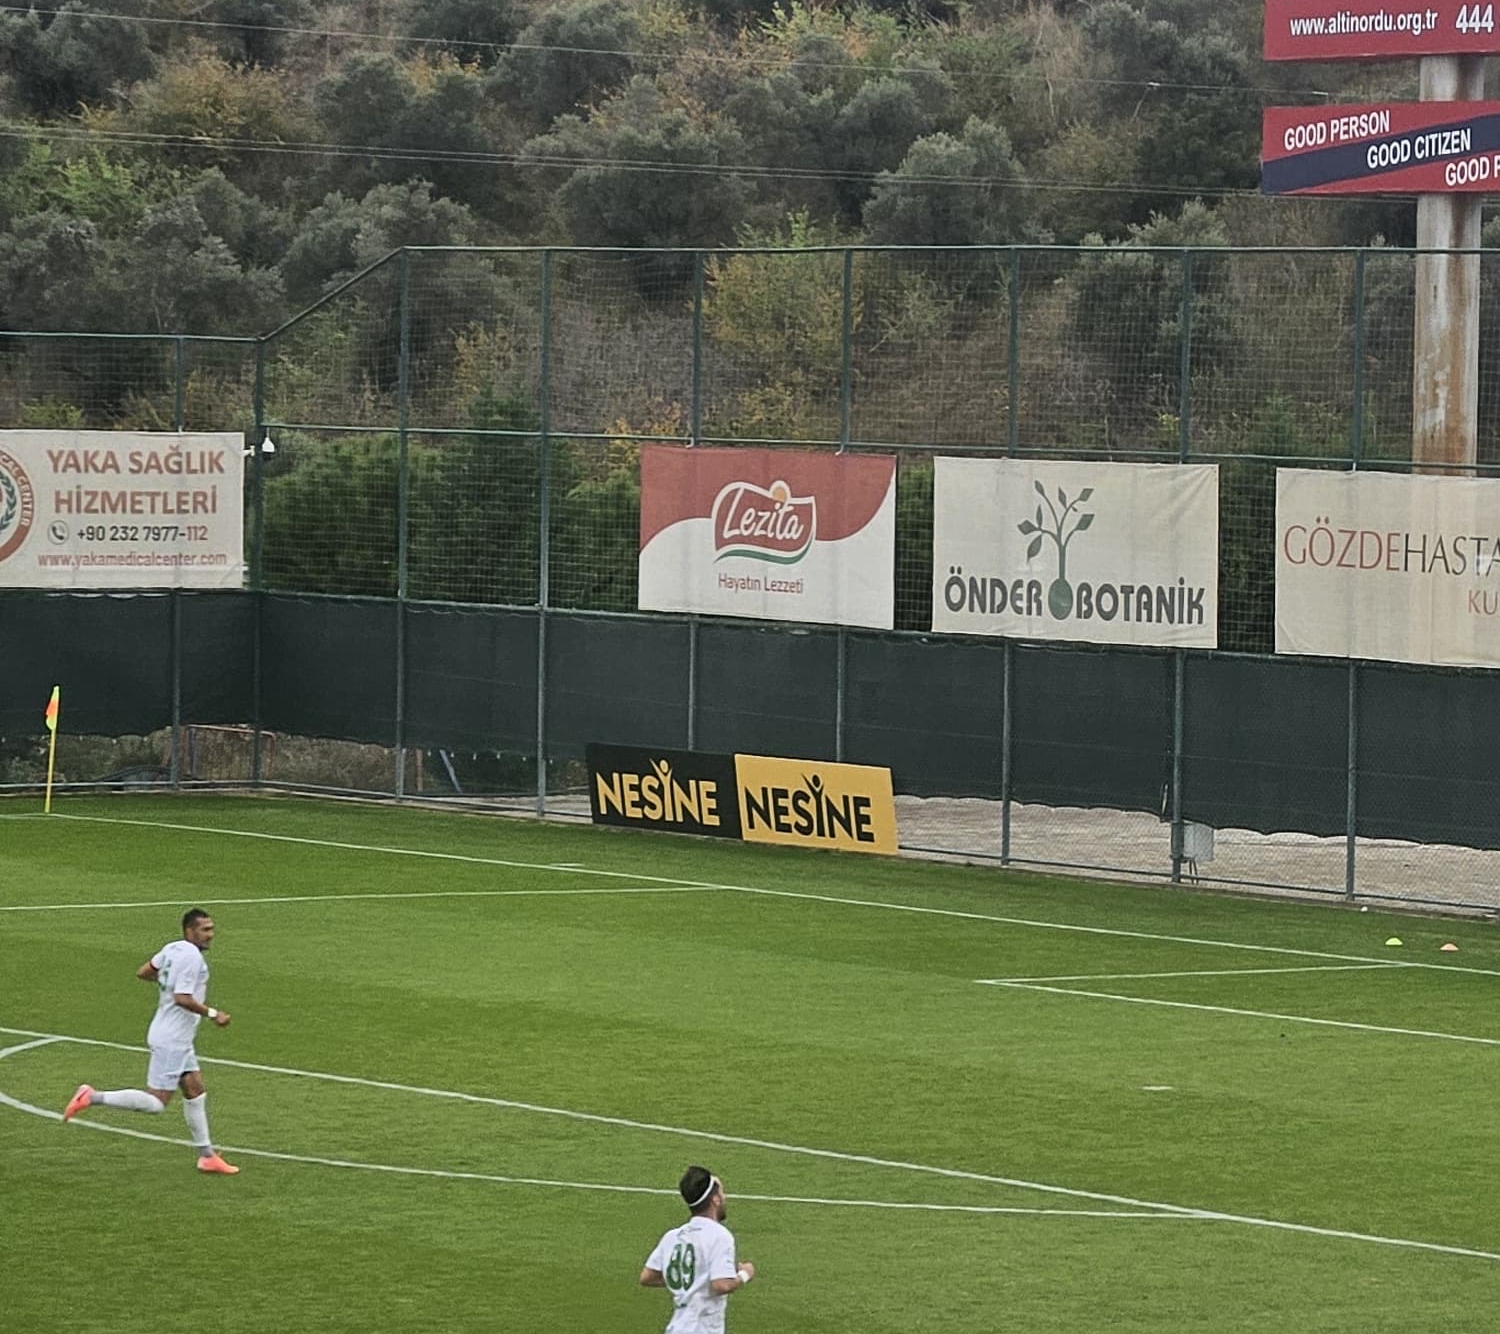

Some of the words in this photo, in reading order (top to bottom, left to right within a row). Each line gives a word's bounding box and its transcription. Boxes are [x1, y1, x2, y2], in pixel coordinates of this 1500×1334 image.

[1290, 10, 1439, 37] www.altinordu.org.tr
[1456, 4, 1494, 34] 444
[1284, 124, 1327, 151] GOOD
[1330, 110, 1391, 143] PERSON
[1367, 140, 1411, 169] GOOD
[1414, 128, 1472, 160] CITIZEN
[1445, 158, 1490, 186] GOOD
[47, 450, 121, 474] YAKA
[128, 445, 226, 475] SAĞLIK
[54, 485, 217, 515] HİZMETLERİ
[722, 486, 804, 540] Lezita
[77, 526, 105, 541] +90
[109, 526, 139, 541] 232
[144, 525, 208, 541] 7977-112
[38, 551, 228, 568] www.yakamedicalcenter.com
[718, 573, 762, 594] Hayatın
[764, 576, 804, 595] Lezzeti
[944, 566, 1043, 617] ÖNDER
[1076, 576, 1206, 625] BOTANİK
